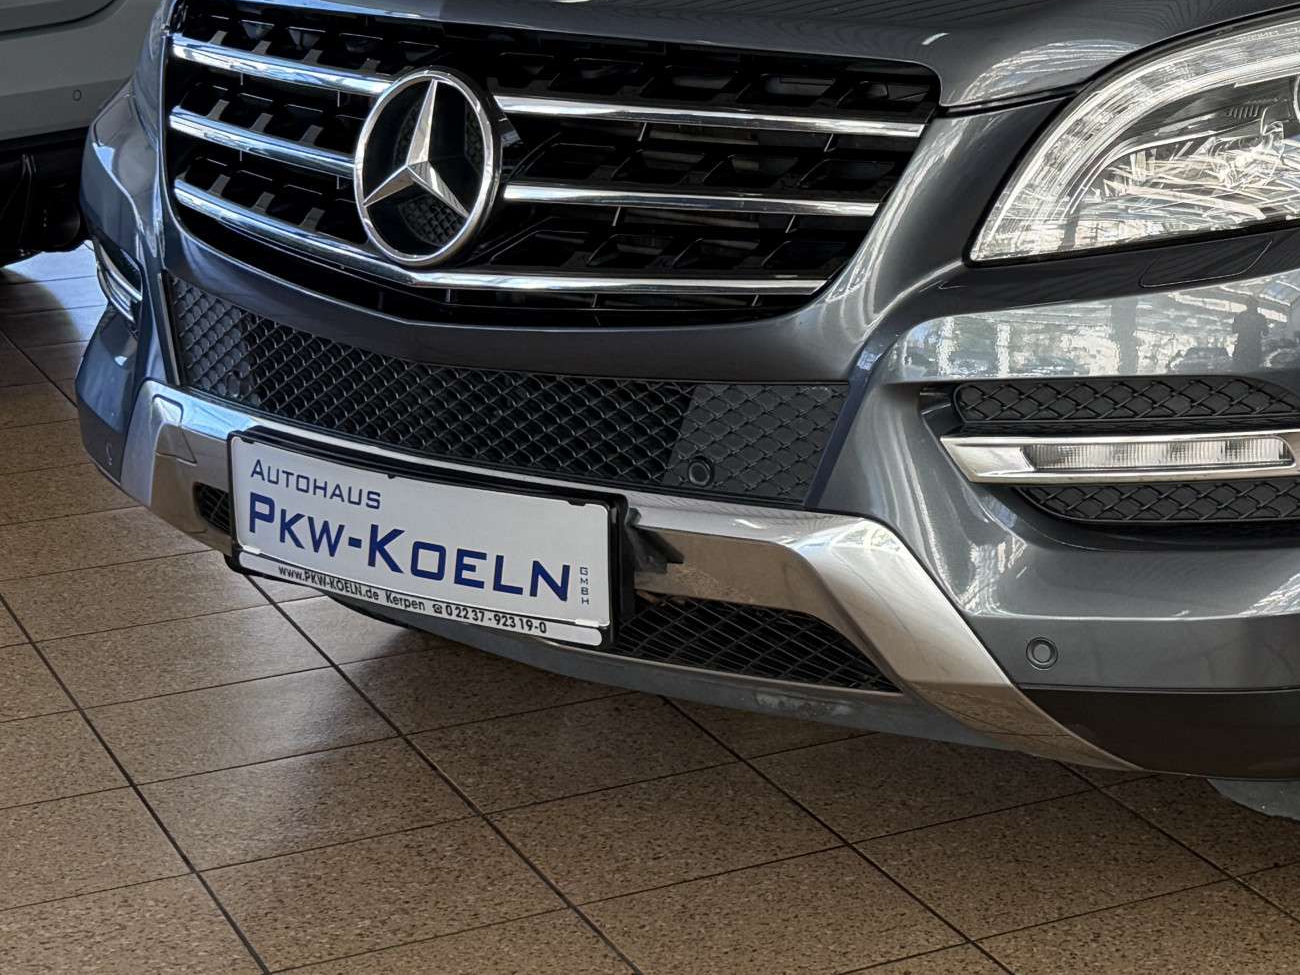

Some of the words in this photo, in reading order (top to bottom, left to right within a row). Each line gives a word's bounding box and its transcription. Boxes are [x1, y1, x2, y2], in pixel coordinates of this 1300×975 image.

[250, 458, 381, 510] AUTOHAUS
[249, 491, 571, 602] PKW-KOELN
[385, 590, 426, 611] Kerpen
